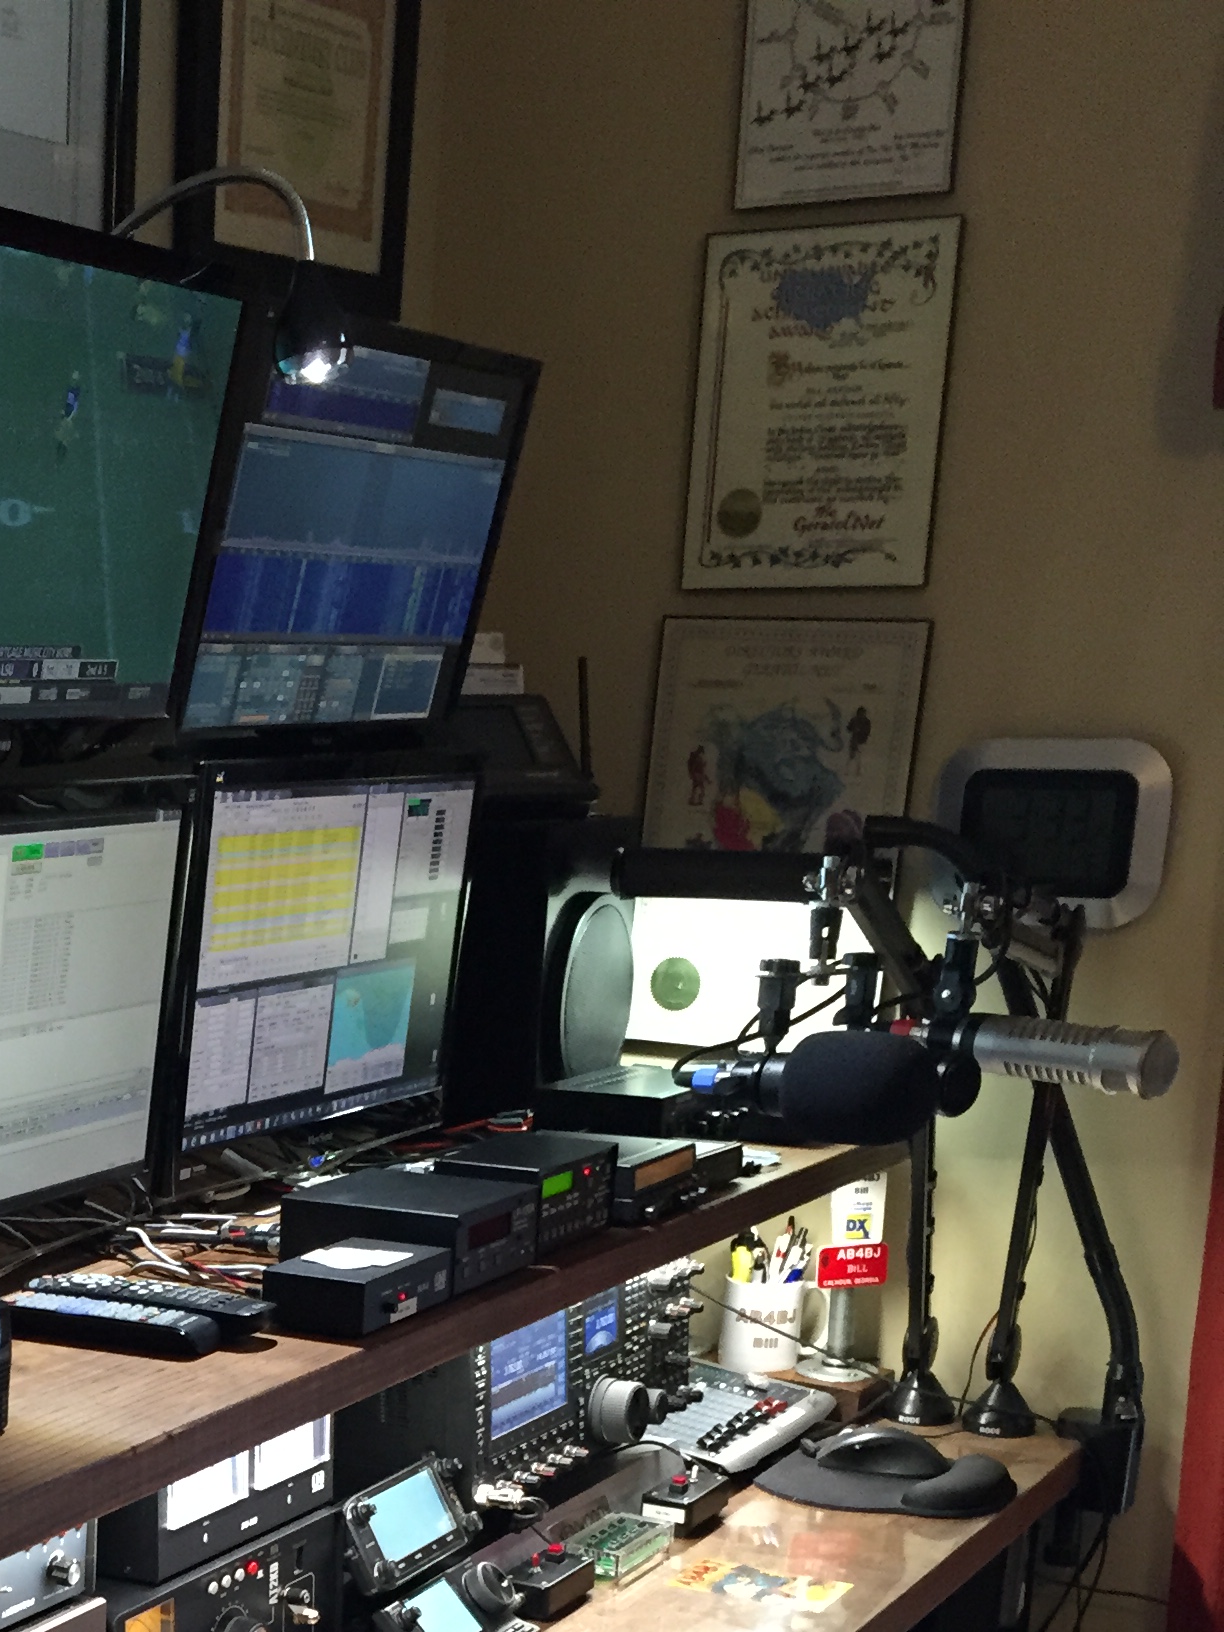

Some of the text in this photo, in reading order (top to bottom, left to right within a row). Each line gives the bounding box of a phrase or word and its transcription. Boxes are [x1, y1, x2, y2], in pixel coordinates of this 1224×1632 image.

[845, 1218, 872, 1240] DX
[836, 1247, 882, 1261] AB4BJ
[846, 1263, 868, 1274] BILL
